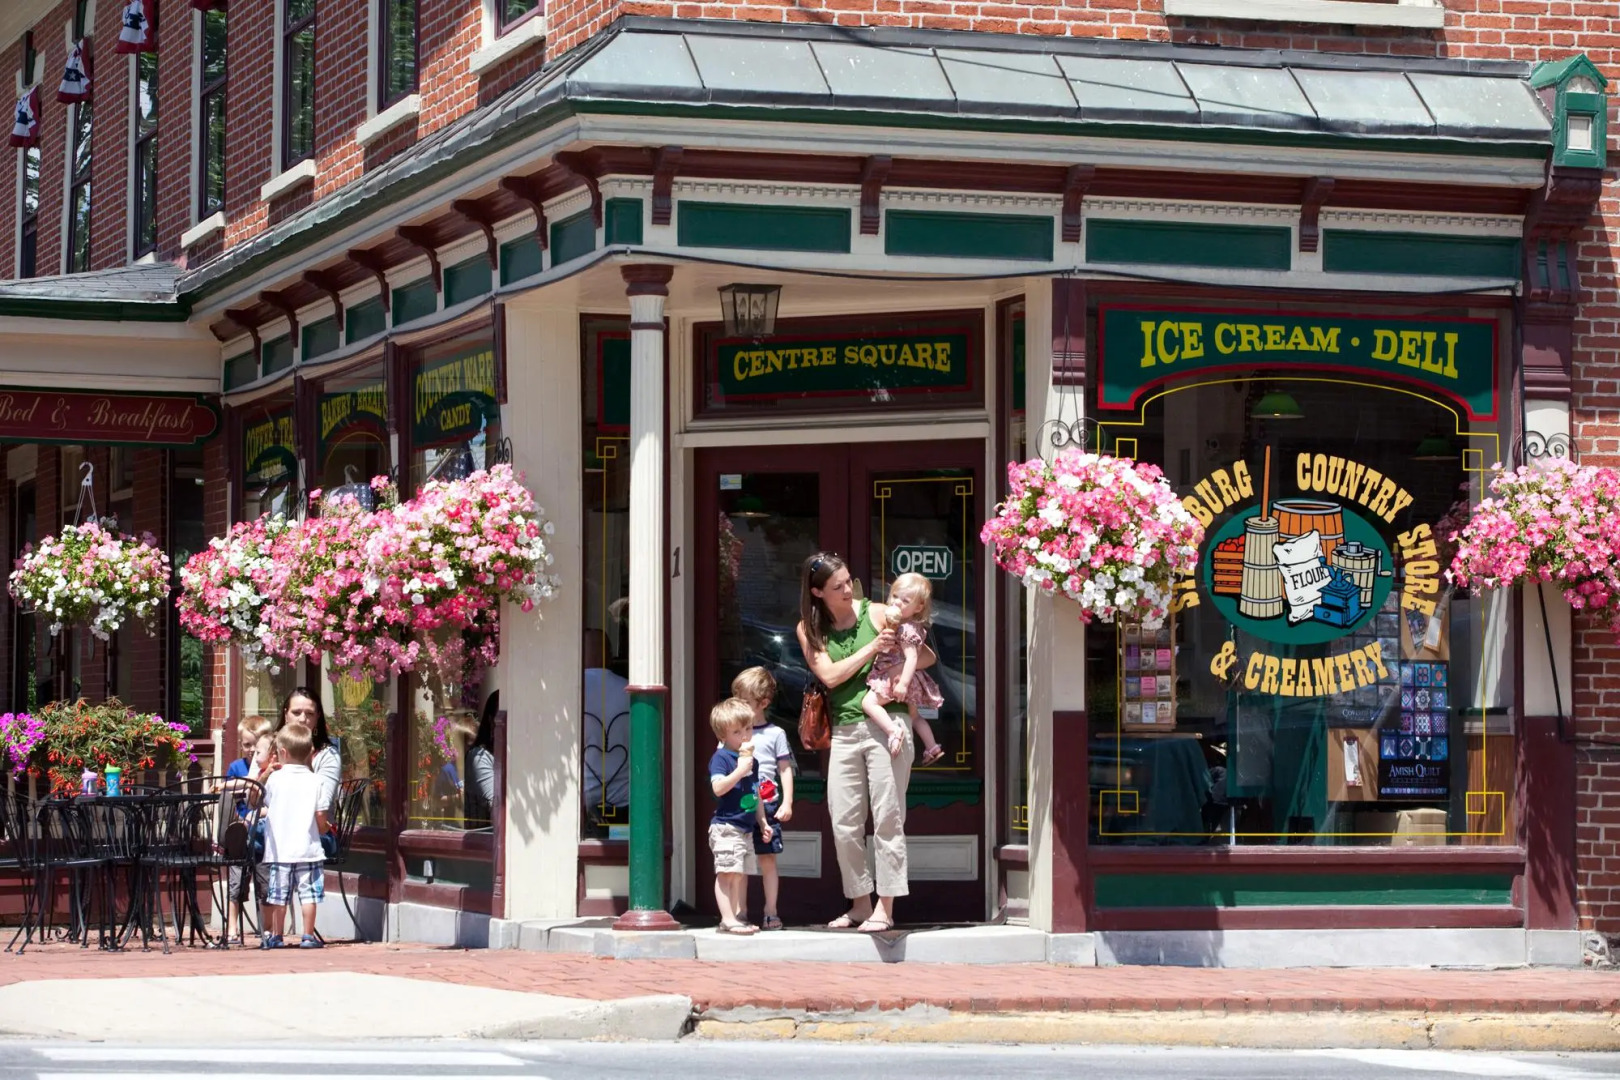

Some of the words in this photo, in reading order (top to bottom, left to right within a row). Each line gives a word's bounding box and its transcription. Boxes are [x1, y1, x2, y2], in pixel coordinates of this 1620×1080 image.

[733, 346, 837, 381] CENTRE
[844, 342, 951, 373] SQUARE
[1140, 320, 1204, 368] ICE
[1214, 322, 1341, 353] CREAM
[1371, 329, 1459, 379] DELI
[416, 360, 462, 425] COUNTRY
[0, 394, 41, 422] Bed
[51, 398, 71, 430] &
[88, 398, 194, 439] Breakfast
[321, 393, 351, 440] BAKERY
[440, 402, 471, 432] CANDY
[1296, 452, 1414, 524] COUNTRY
[1397, 522, 1441, 616] STORE
[672, 546, 681, 578] 1
[896, 550, 948, 574] OPEN
[1290, 567, 1330, 591] FLOUR
[1210, 640, 1237, 680] &
[1244, 640, 1390, 697] CREAMERY
